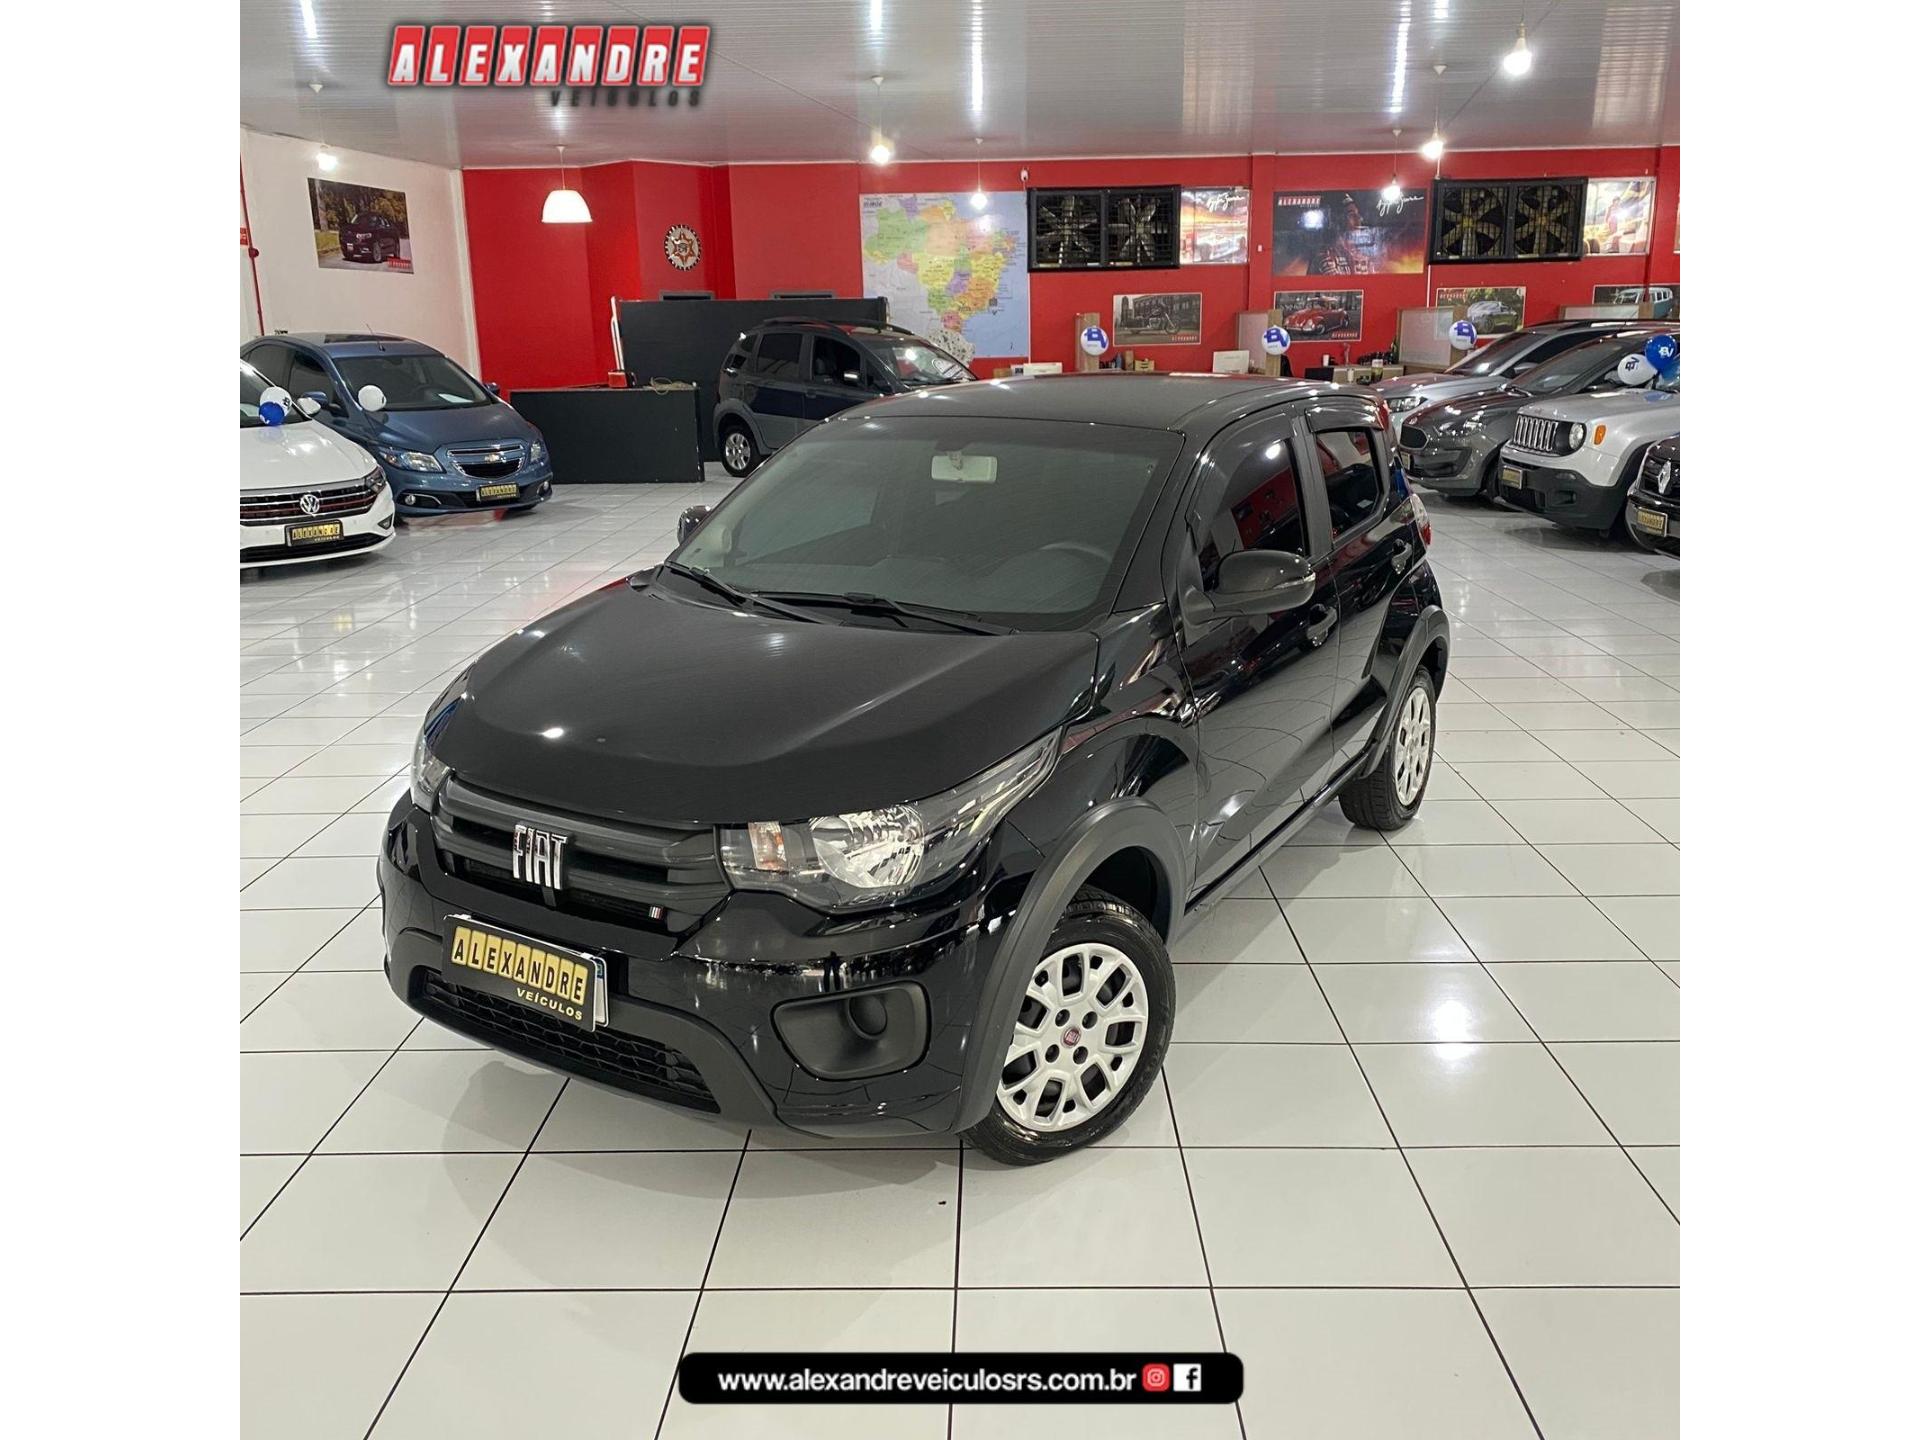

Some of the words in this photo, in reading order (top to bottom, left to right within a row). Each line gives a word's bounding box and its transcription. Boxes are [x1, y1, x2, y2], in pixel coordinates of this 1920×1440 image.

[513, 824, 567, 890] FIAT
[453, 938, 584, 1002] ALEXANDRE
[516, 987, 583, 1021] VEÍCULOS
